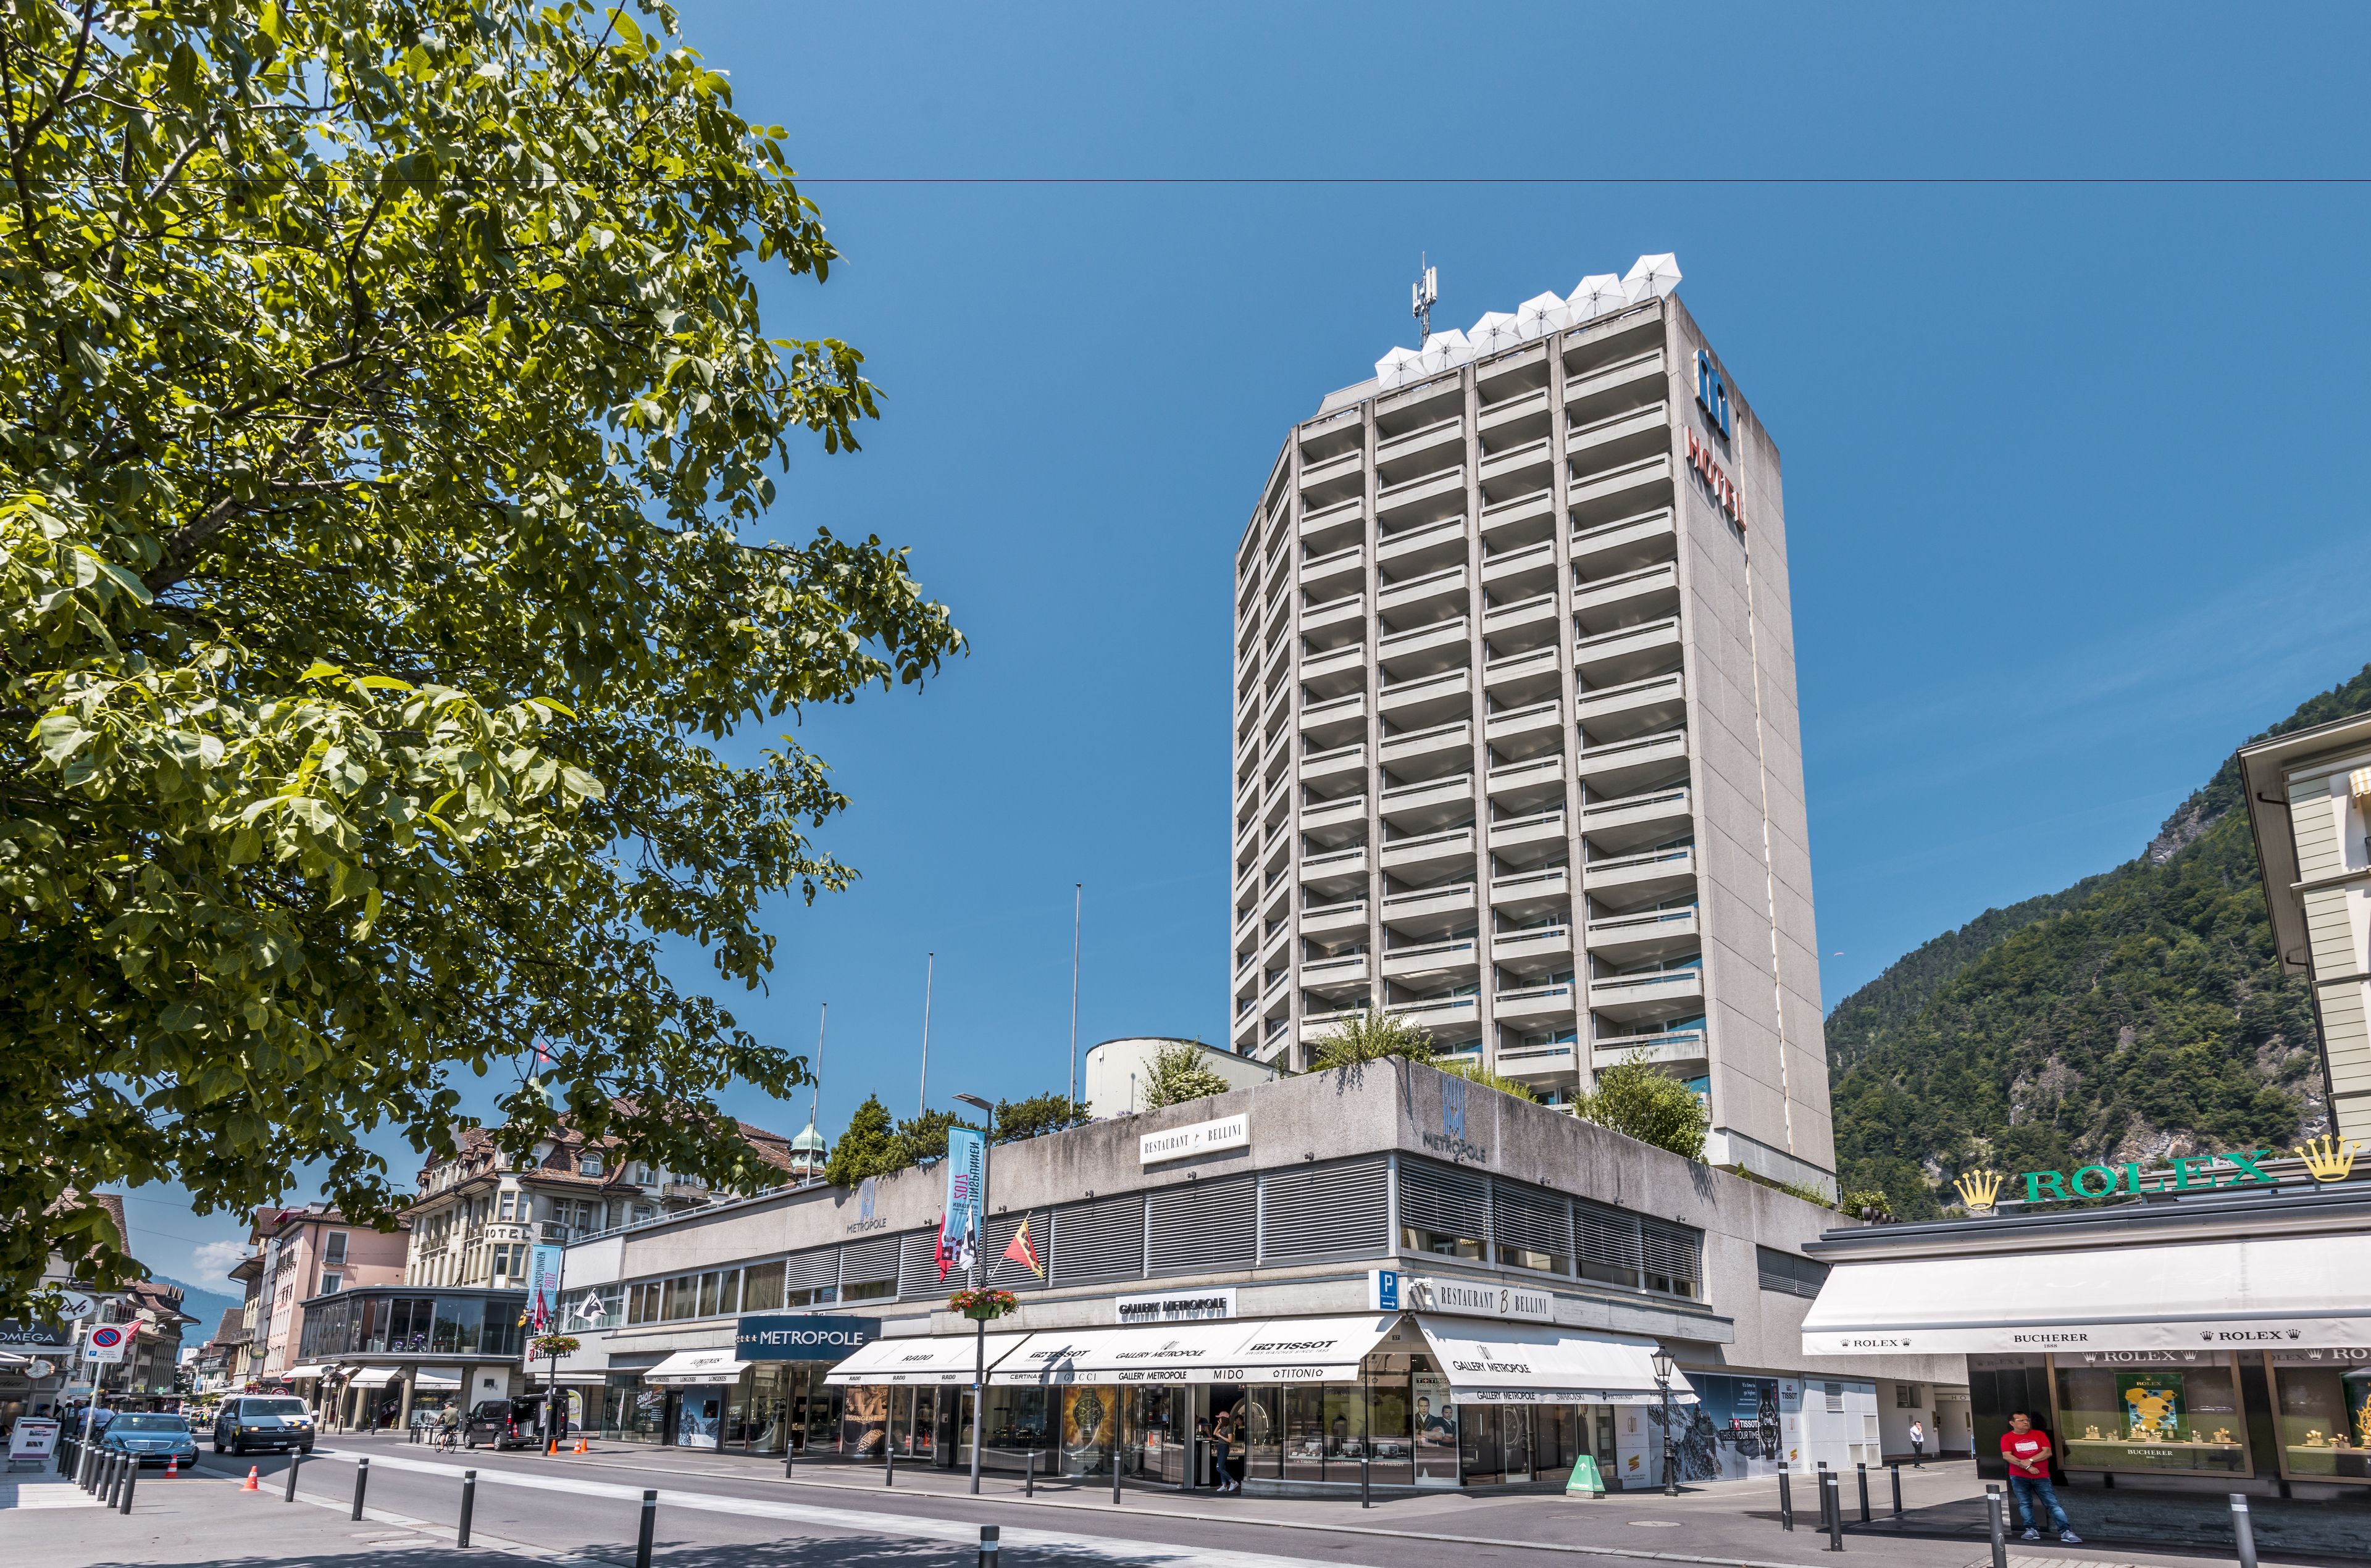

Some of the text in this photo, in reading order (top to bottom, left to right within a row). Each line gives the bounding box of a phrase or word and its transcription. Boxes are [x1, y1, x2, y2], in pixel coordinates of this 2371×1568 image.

[1686, 425, 1746, 532] HOTEL
[1145, 1124, 1241, 1154] RESTAURANT BELLINI
[1423, 1131, 1486, 1164] METROPOLE
[2021, 1149, 2280, 1203] ROLEX
[847, 1218, 887, 1234] METROPOLE
[534, 1251, 546, 1288] UNSPUNNEN
[544, 1272, 556, 1289] 2017
[1384, 1275, 1393, 1292] P
[1119, 1298, 1227, 1315] GALLERY METROPOLE
[1441, 1287, 1494, 1309] RESTAURANT
[1515, 1296, 1546, 1314] BELLINI
[759, 1331, 863, 1345] METROPOLE
[2014, 1333, 2088, 1343] BUCHERER
[2219, 1331, 2283, 1340] ROLEX
[1275, 1340, 1338, 1350] TISSOT
[1047, 1350, 1092, 1358] TISSOT
[2104, 1351, 2177, 1362] ROLEX
[1281, 1369, 1315, 1378] TITONI
[1453, 1361, 1531, 1374] GALLERY METROPOLE
[1064, 1373, 1097, 1381] GUCCI
[1118, 1371, 1187, 1380] GALLERY METROPOLE
[1214, 1369, 1244, 1379] MIDO
[637, 1391, 653, 1404] SHOP
[1477, 1391, 1536, 1400] GALLERY METROPOLE
[1556, 1393, 1585, 1401] SWAROVSKI
[1739, 1420, 1758, 1428] TISSOT
[1720, 1430, 1759, 1440] THIS IS YOUR TIME
